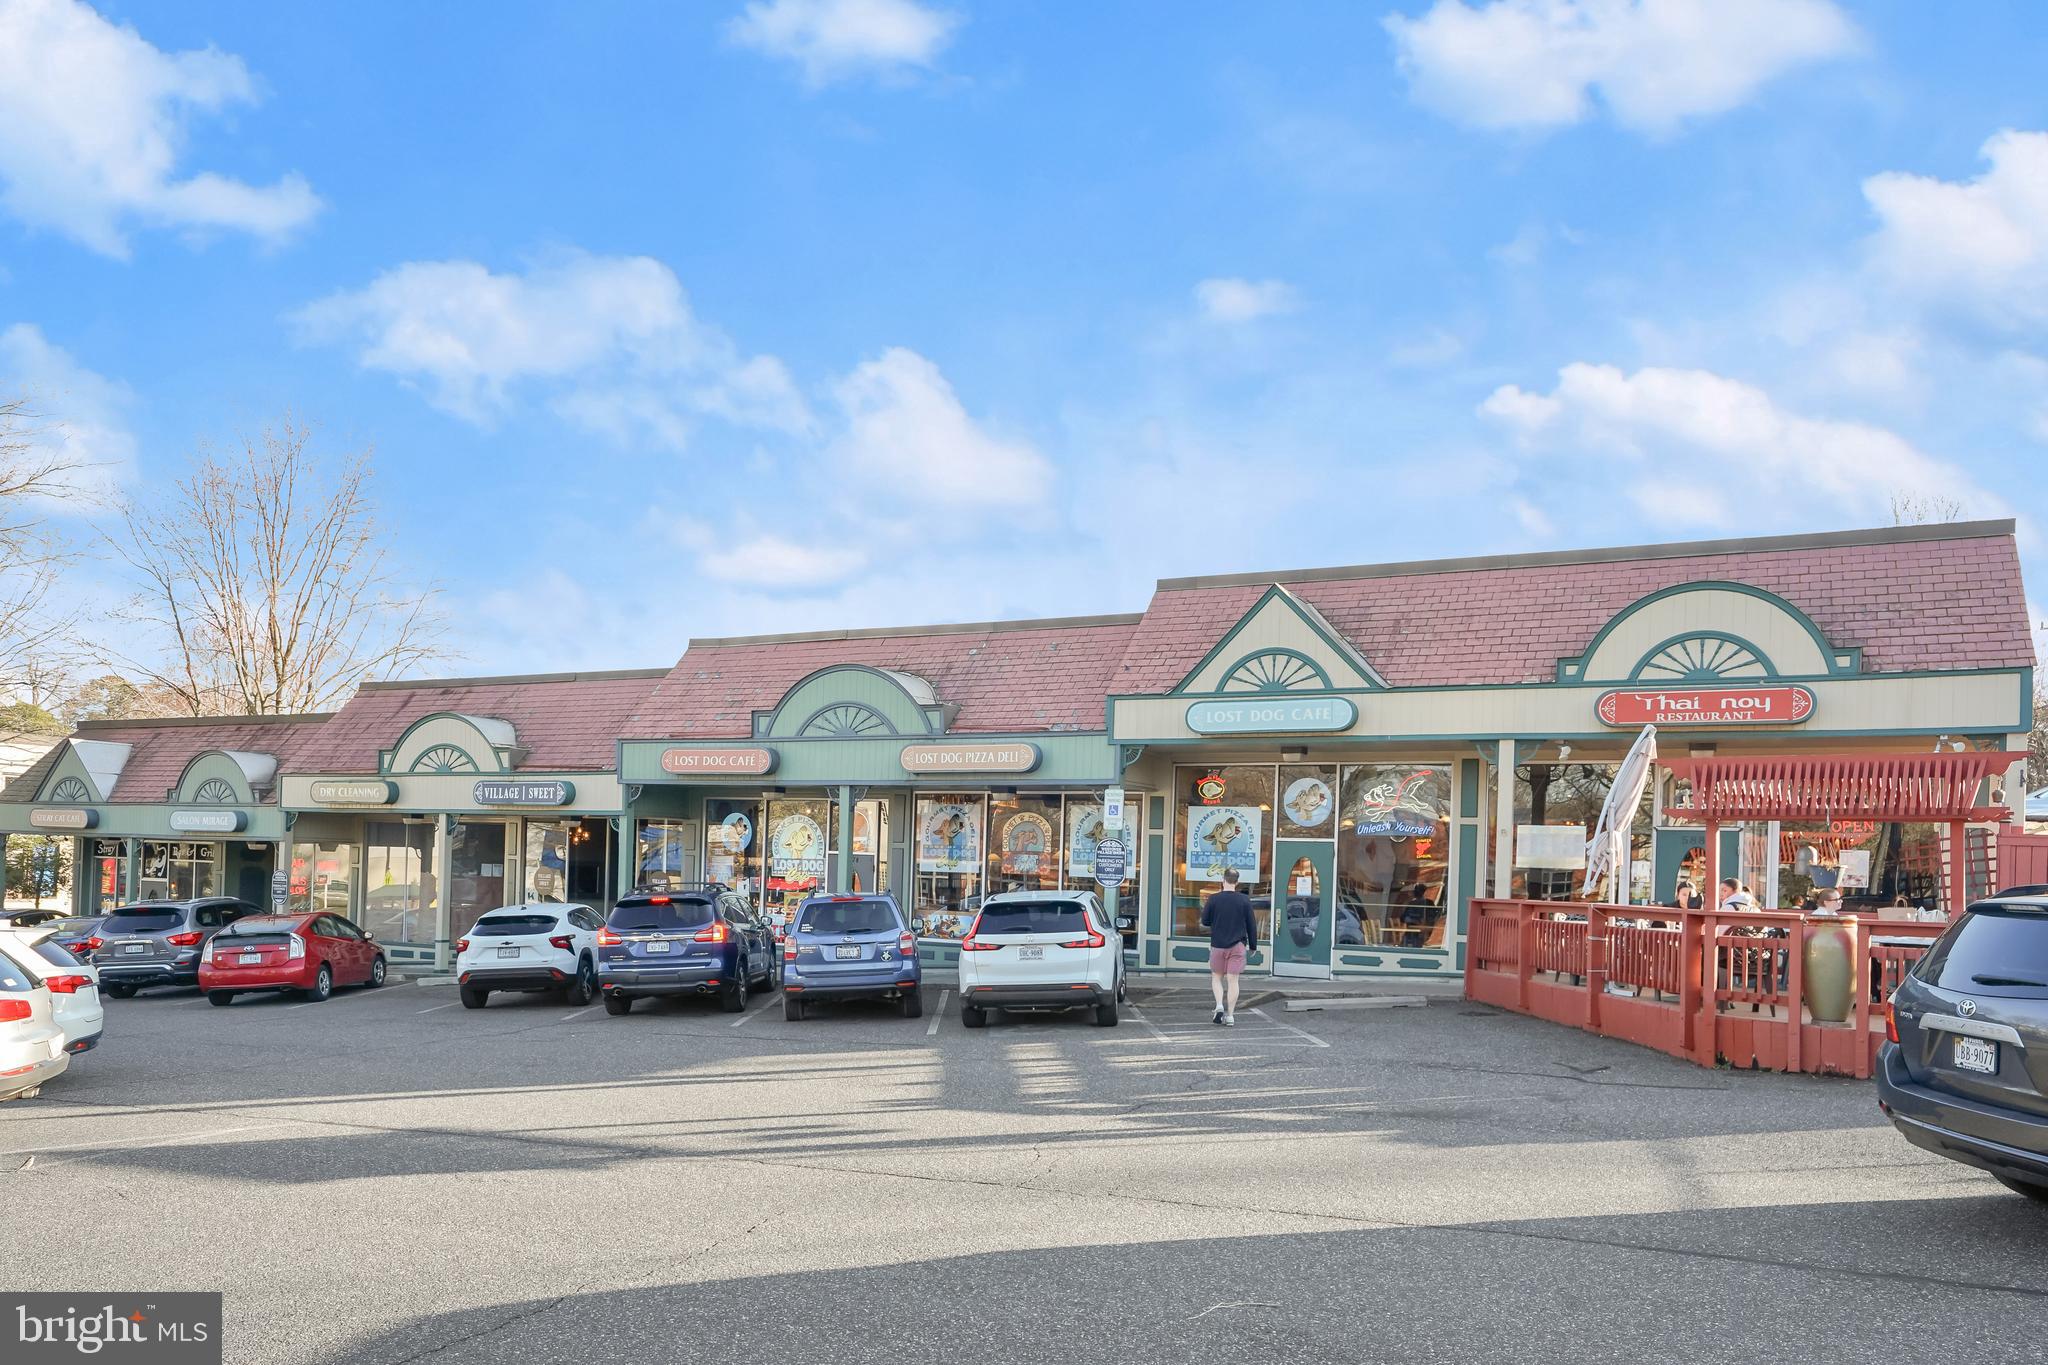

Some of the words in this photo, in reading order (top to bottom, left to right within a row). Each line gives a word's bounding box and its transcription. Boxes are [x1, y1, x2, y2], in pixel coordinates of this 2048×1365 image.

[1635, 693, 1699, 711] Thai
[1721, 697, 1771, 713] noy
[1206, 711, 1243, 723] LOST
[1251, 709, 1285, 722] DOG
[1656, 711, 1754, 721] RESTAURANT
[674, 755, 700, 766] LOST
[703, 755, 726, 766] DOG
[915, 752, 938, 764] LOST
[941, 752, 962, 764] DOG
[965, 751, 995, 763] PIZZA
[997, 751, 1019, 763] DELI
[320, 787, 336, 797] DRY
[338, 787, 380, 797] CLEANING
[484, 787, 520, 799] VILLAGE
[528, 787, 556, 799] SWEET
[176, 815, 200, 825] SALON
[202, 815, 229, 826] MIRAGE
[1193, 808, 1222, 848] GOURMET
[1225, 808, 1249, 826] PIZZA
[1247, 825, 1255, 850] DELI
[1357, 821, 1392, 835] Unleash
[1395, 821, 1435, 835] Yourself!
[1830, 821, 1875, 833] OPEN
[773, 860, 799, 871] LOST
[802, 860, 824, 872] DOG
[1191, 855, 1224, 865] LOST
[1227, 856, 1255, 866] DOG
